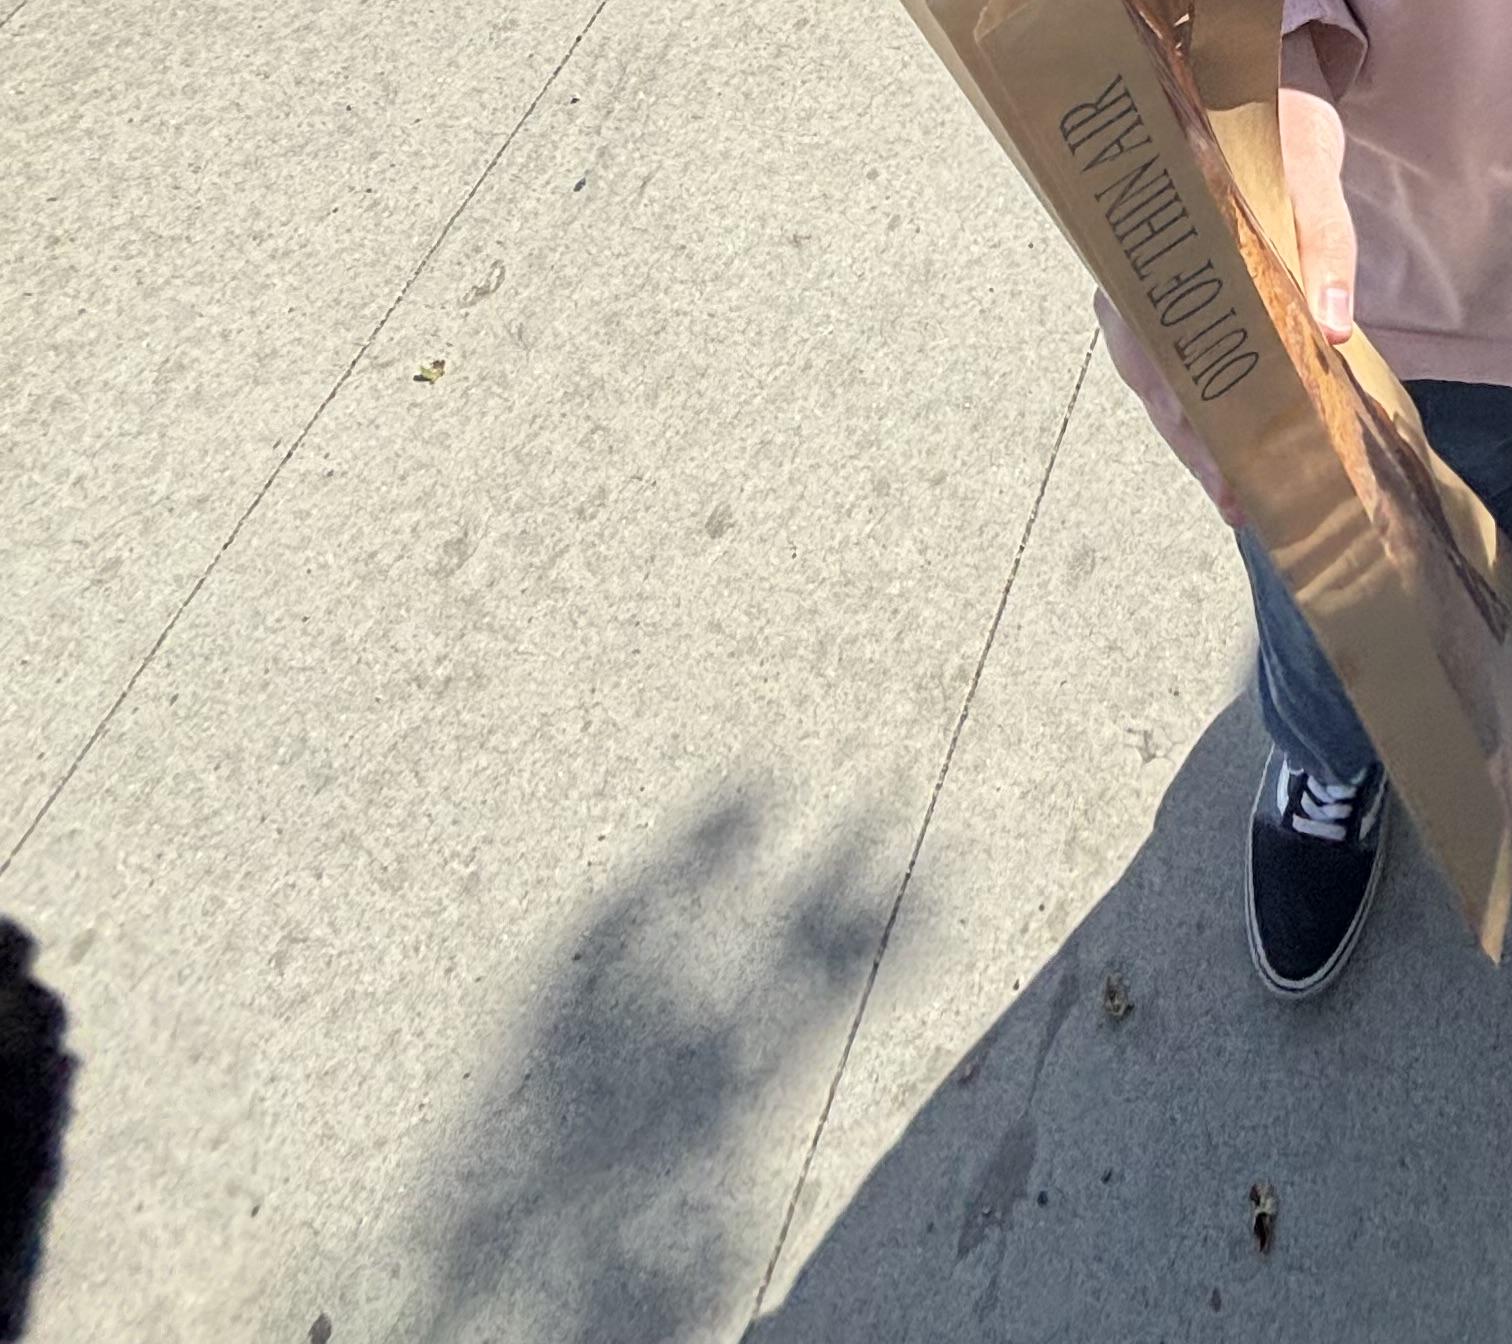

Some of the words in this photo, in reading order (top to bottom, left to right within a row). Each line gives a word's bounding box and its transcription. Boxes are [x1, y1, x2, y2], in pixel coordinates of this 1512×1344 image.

[1059, 73, 1153, 172] AIR
[1094, 153, 1199, 281] THIN
[1147, 259, 1224, 327] OF
[1173, 307, 1259, 402] OUT
